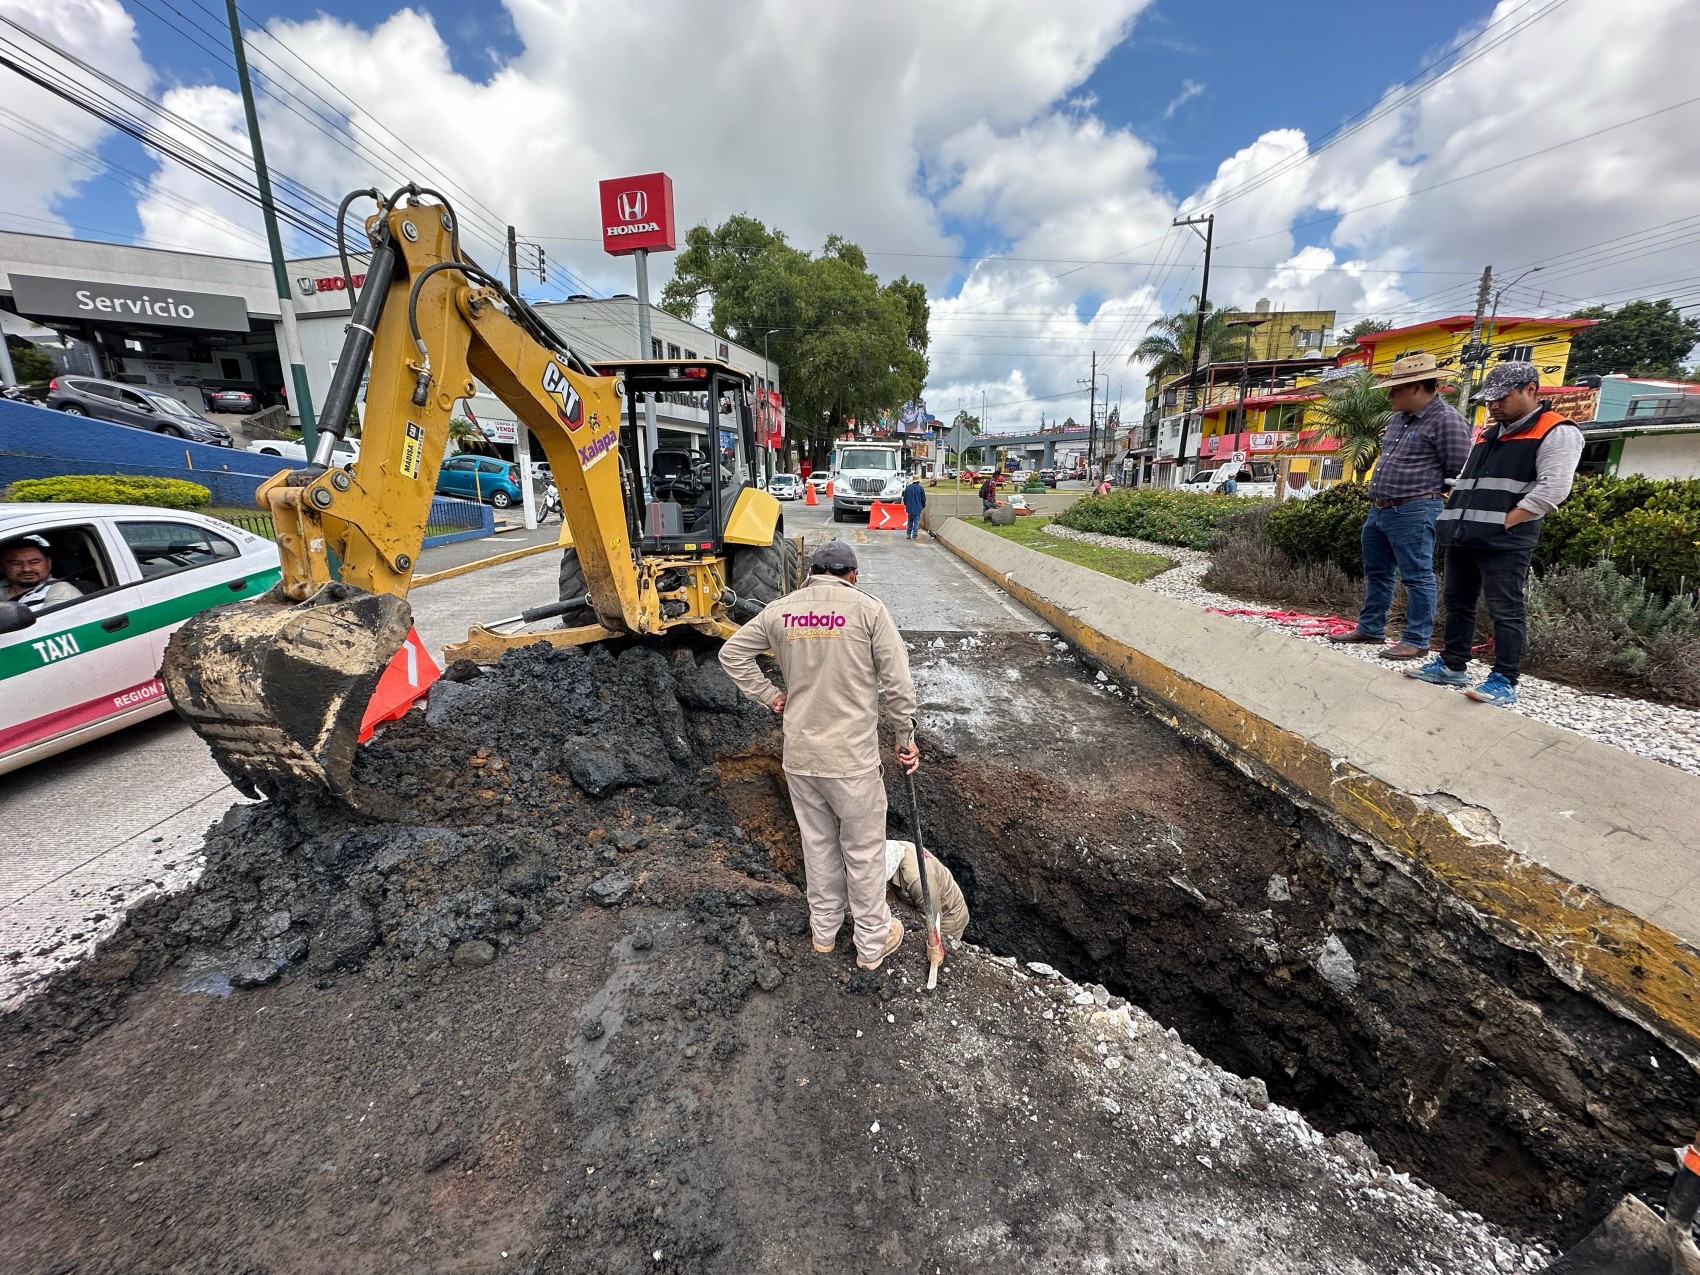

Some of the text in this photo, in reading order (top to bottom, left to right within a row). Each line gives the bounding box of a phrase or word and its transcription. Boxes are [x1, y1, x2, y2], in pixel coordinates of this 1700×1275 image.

[606, 222, 661, 236] HONDA
[314, 274, 367, 292] HON
[76, 290, 194, 319] Servicio
[543, 362, 580, 418] CAT
[404, 444, 414, 473] MADISA
[578, 430, 617, 466] Xalapa
[782, 611, 846, 630] Trabajo
[32, 633, 80, 662] TAXI
[113, 684, 159, 708] REGIÓN
